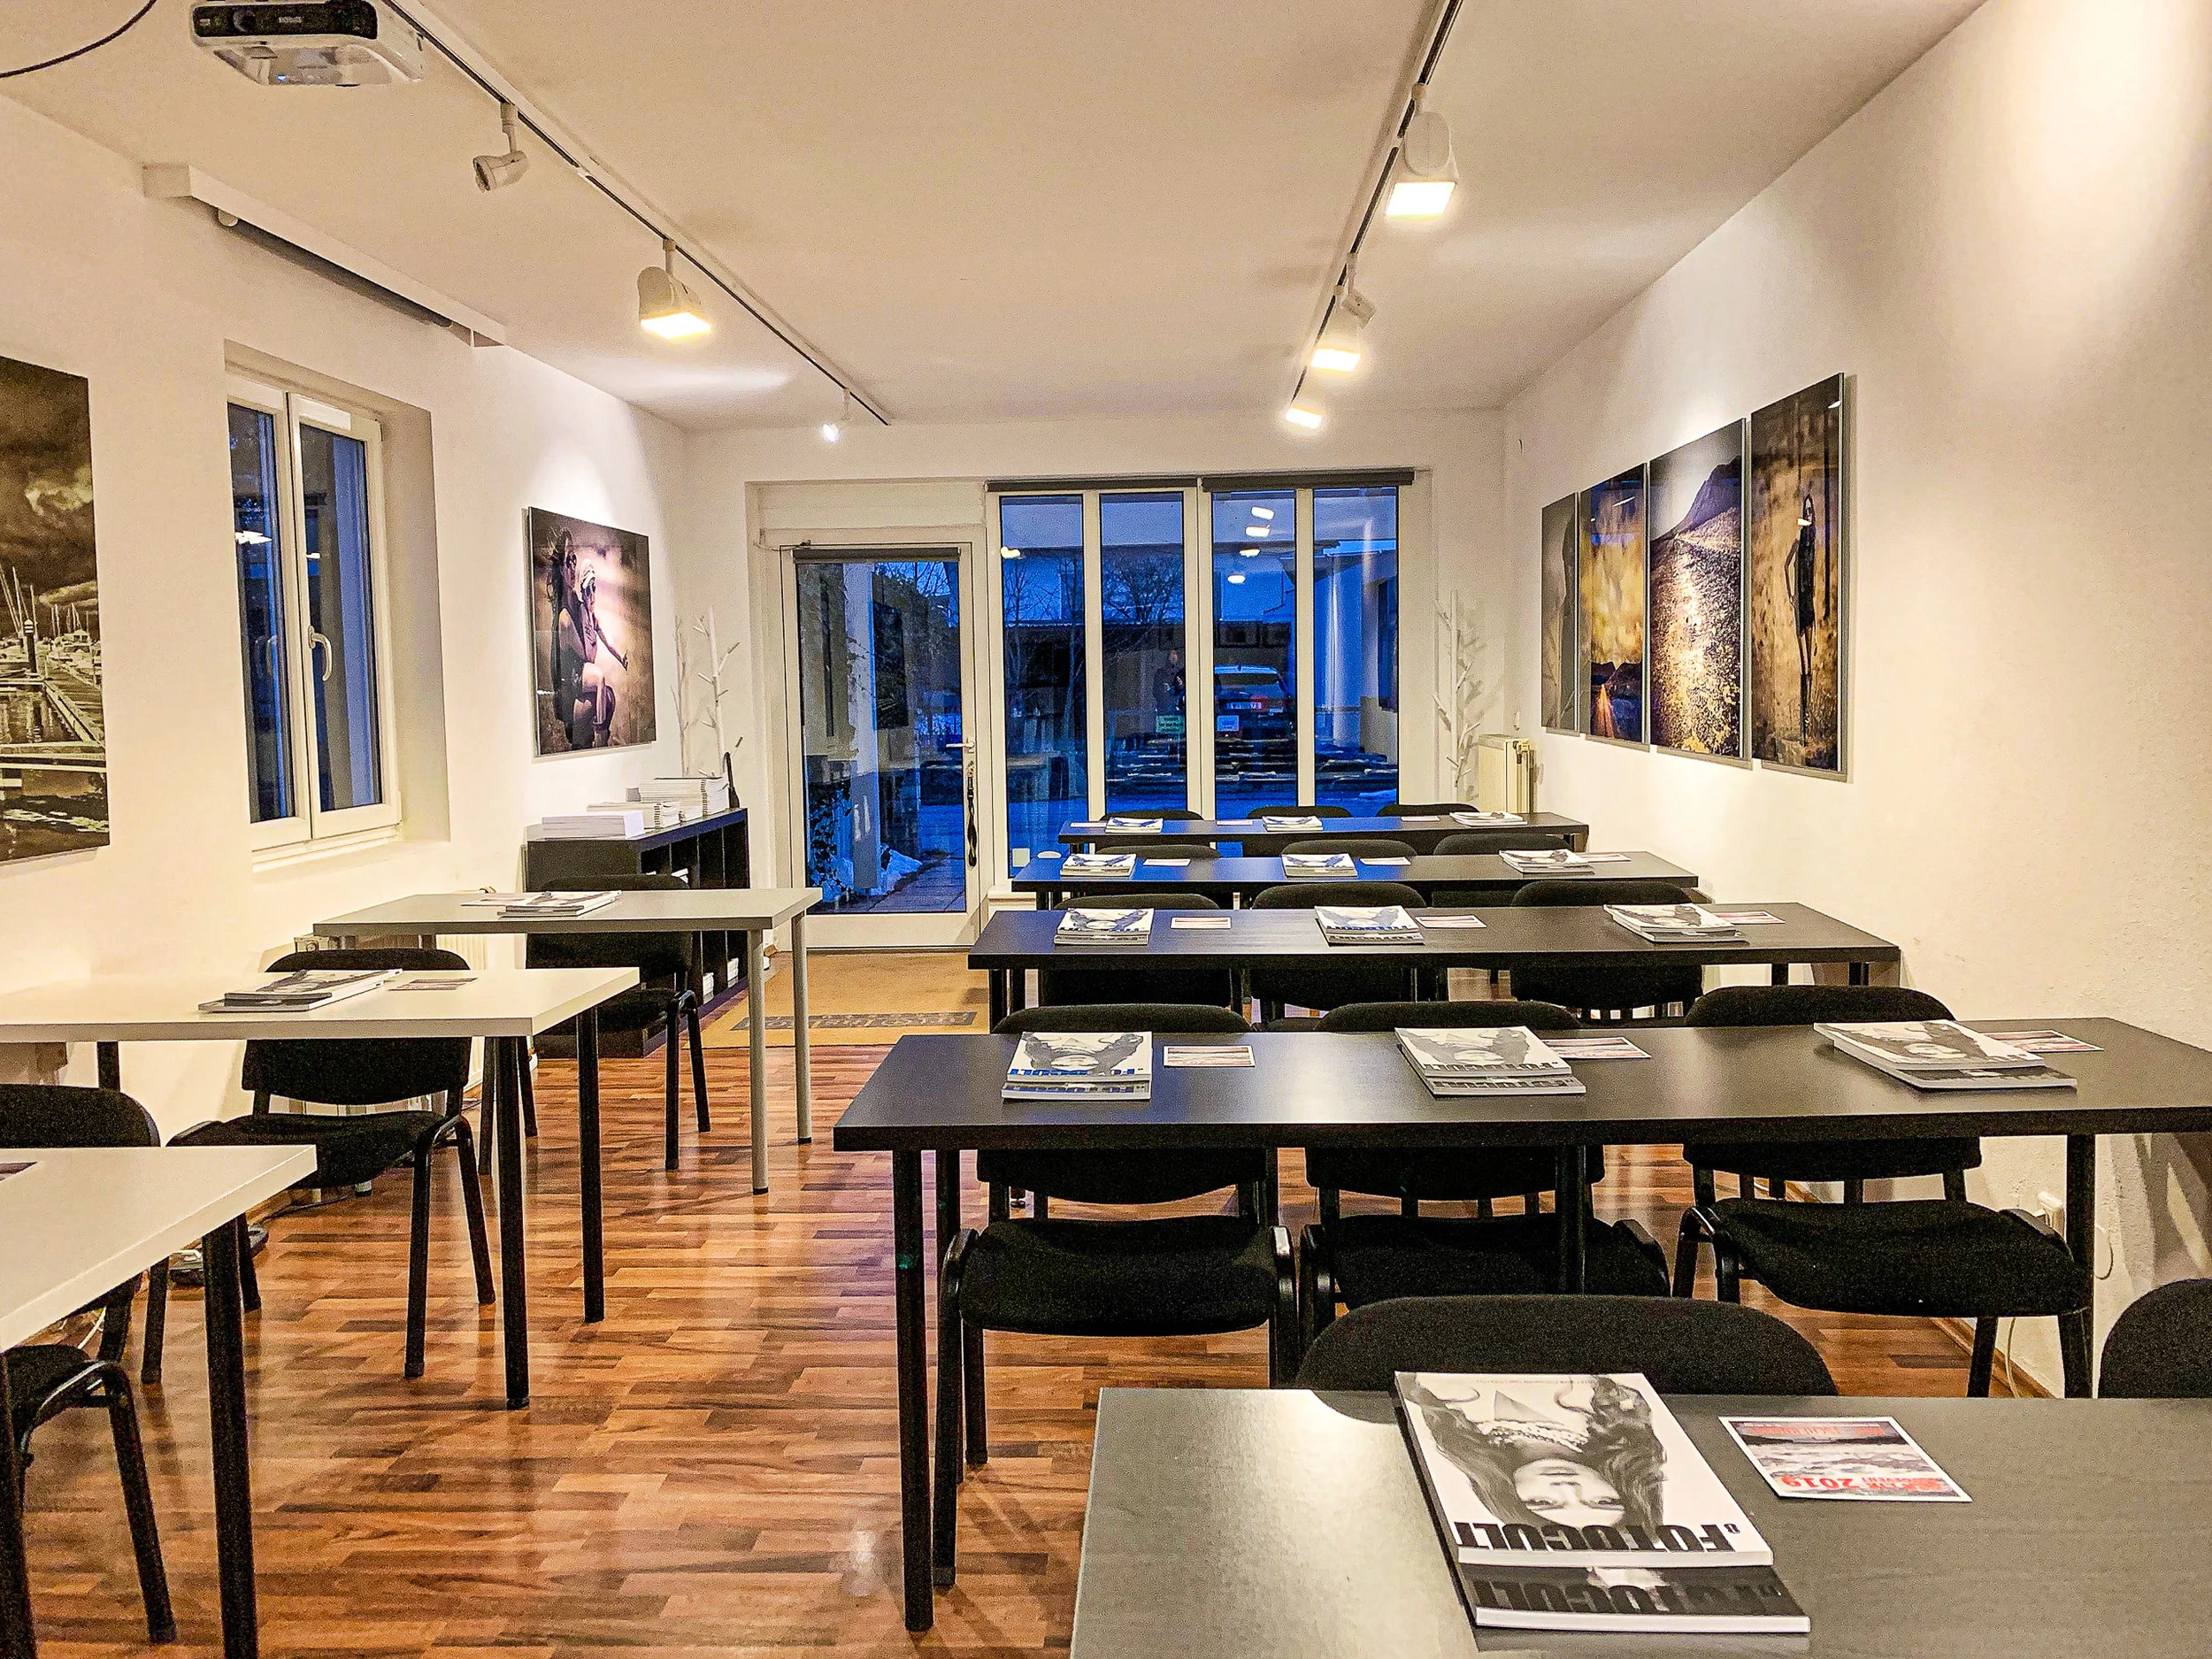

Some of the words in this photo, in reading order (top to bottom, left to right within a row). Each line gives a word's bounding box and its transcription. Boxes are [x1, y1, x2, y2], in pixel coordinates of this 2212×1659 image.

[1781, 1475, 1859, 1490] 2019
[1724, 1523, 1741, 1535] 8
[1454, 1522, 1737, 1553] FOTOCULT
